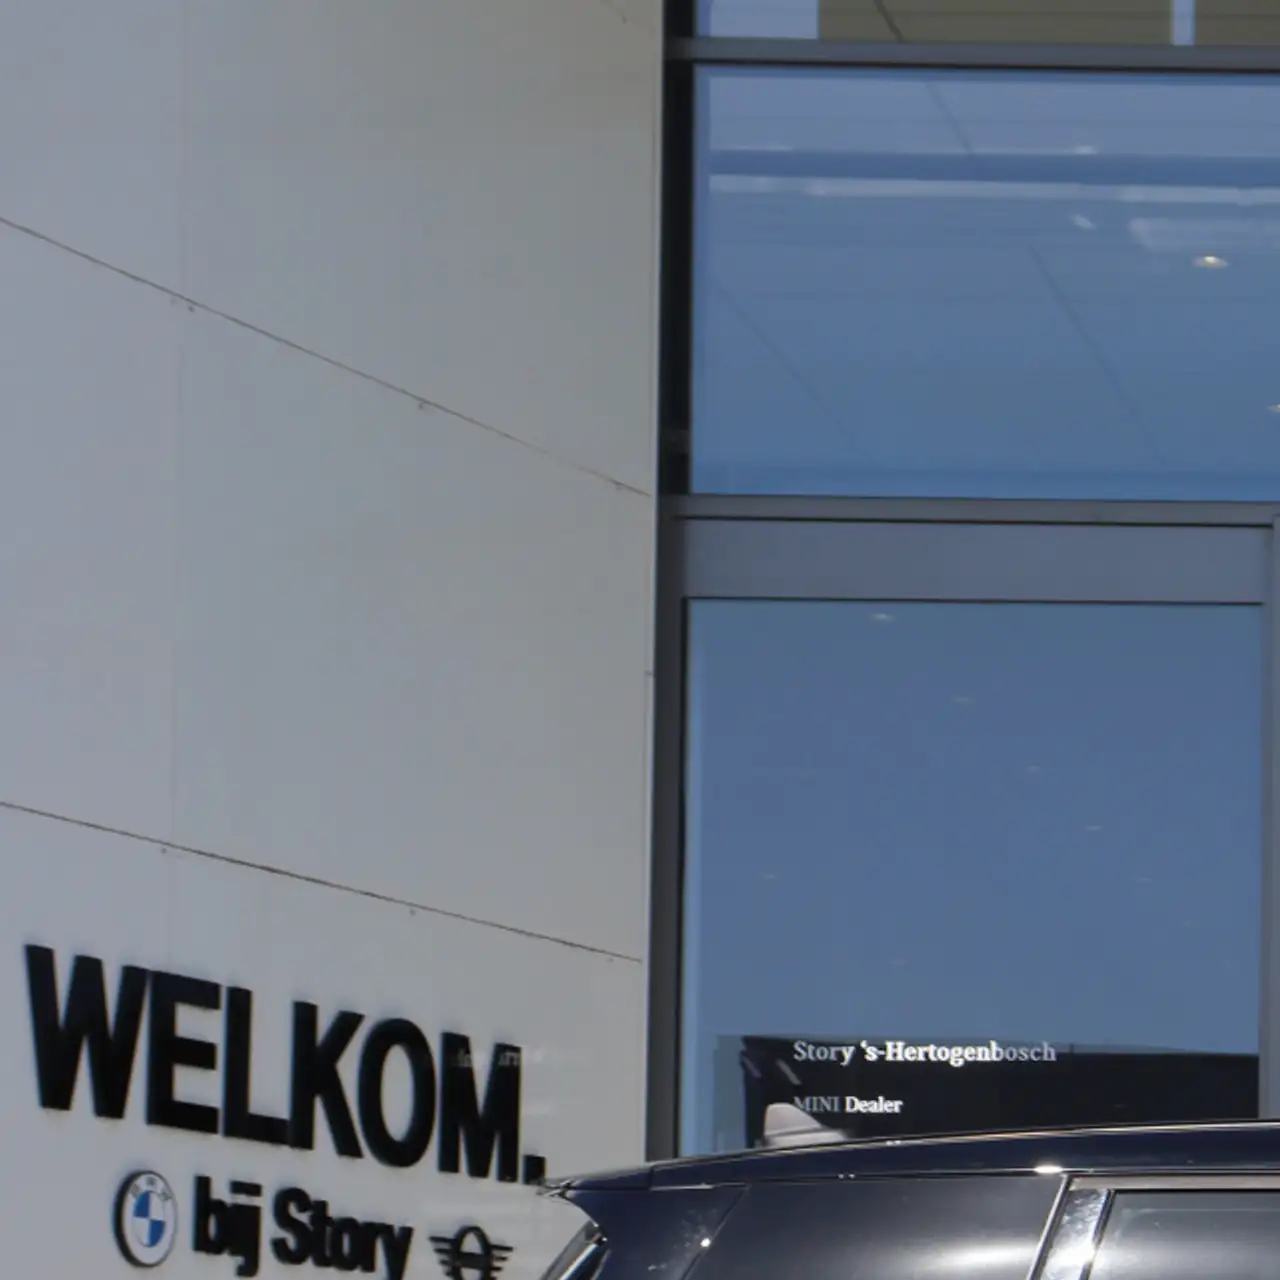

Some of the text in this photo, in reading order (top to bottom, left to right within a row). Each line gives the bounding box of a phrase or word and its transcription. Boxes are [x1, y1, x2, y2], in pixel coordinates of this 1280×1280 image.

[24, 944, 546, 1184] WELKOM.
[794, 1041, 855, 1066] Story
[793, 1095, 904, 1114] MINI Dealer
[193, 1175, 262, 1277] bij
